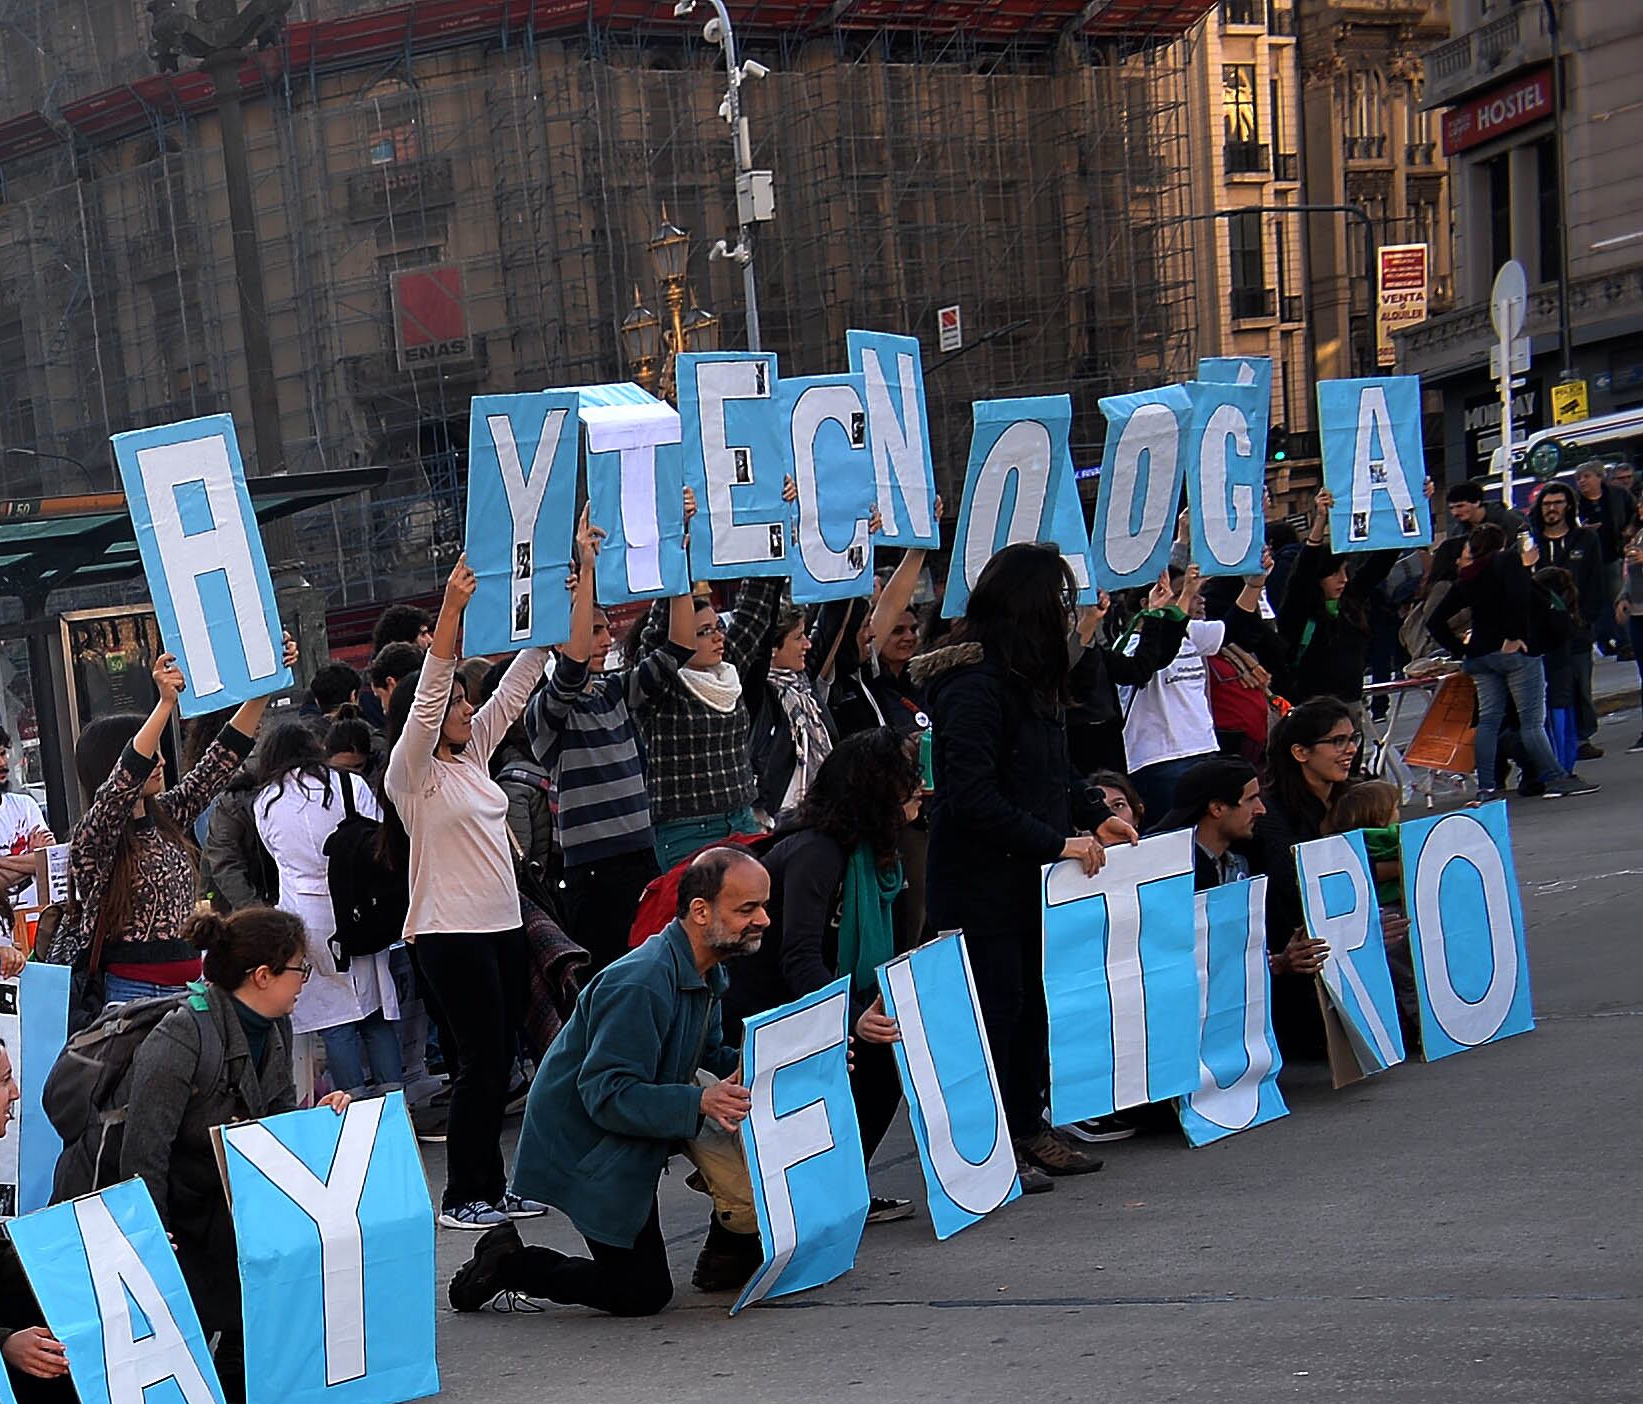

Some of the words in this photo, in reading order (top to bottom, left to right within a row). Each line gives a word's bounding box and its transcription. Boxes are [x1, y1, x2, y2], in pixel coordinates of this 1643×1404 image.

[1477, 84, 1544, 130] HOSTEL
[1381, 292, 1424, 304] VENTA
[487, 409, 570, 642] Y
